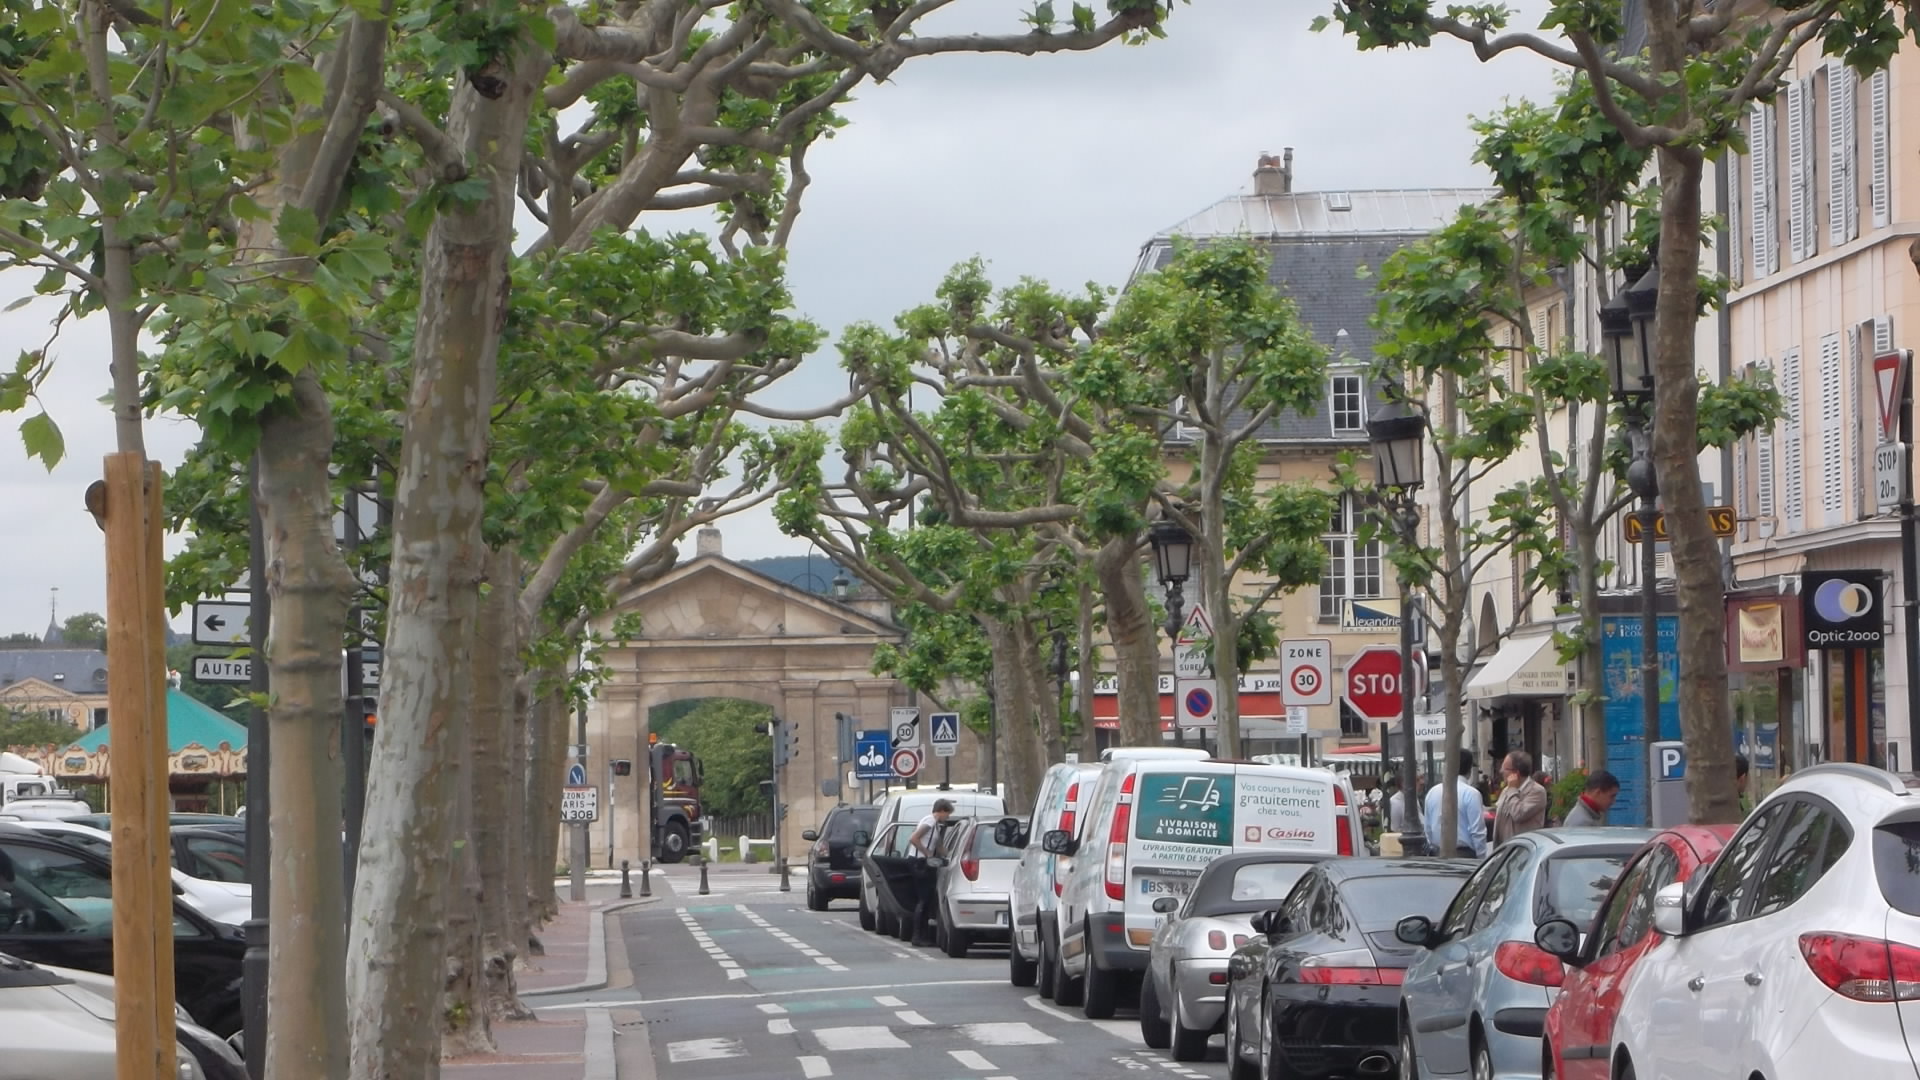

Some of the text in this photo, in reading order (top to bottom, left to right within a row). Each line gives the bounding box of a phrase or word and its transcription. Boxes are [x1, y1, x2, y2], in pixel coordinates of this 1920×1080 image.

[1878, 450, 1897, 471] STOP
[1289, 649, 1322, 657] ZONE
[1298, 675, 1315, 686] 30
[1353, 674, 1403, 694] STO
[899, 728, 911, 737] 30
[1241, 782, 1256, 792] Vos
[1258, 785, 1291, 794] courses
[1240, 794, 1321, 808] gratuitement
[570, 811, 593, 819] 308
[1258, 807, 1277, 816] chez
[1160, 819, 1217, 830] LIVRAISON
[1167, 828, 1218, 838] DOMICILE
[1267, 827, 1315, 839] Casino
[1142, 844, 1223, 856] LIVRAISON GRATUITE
